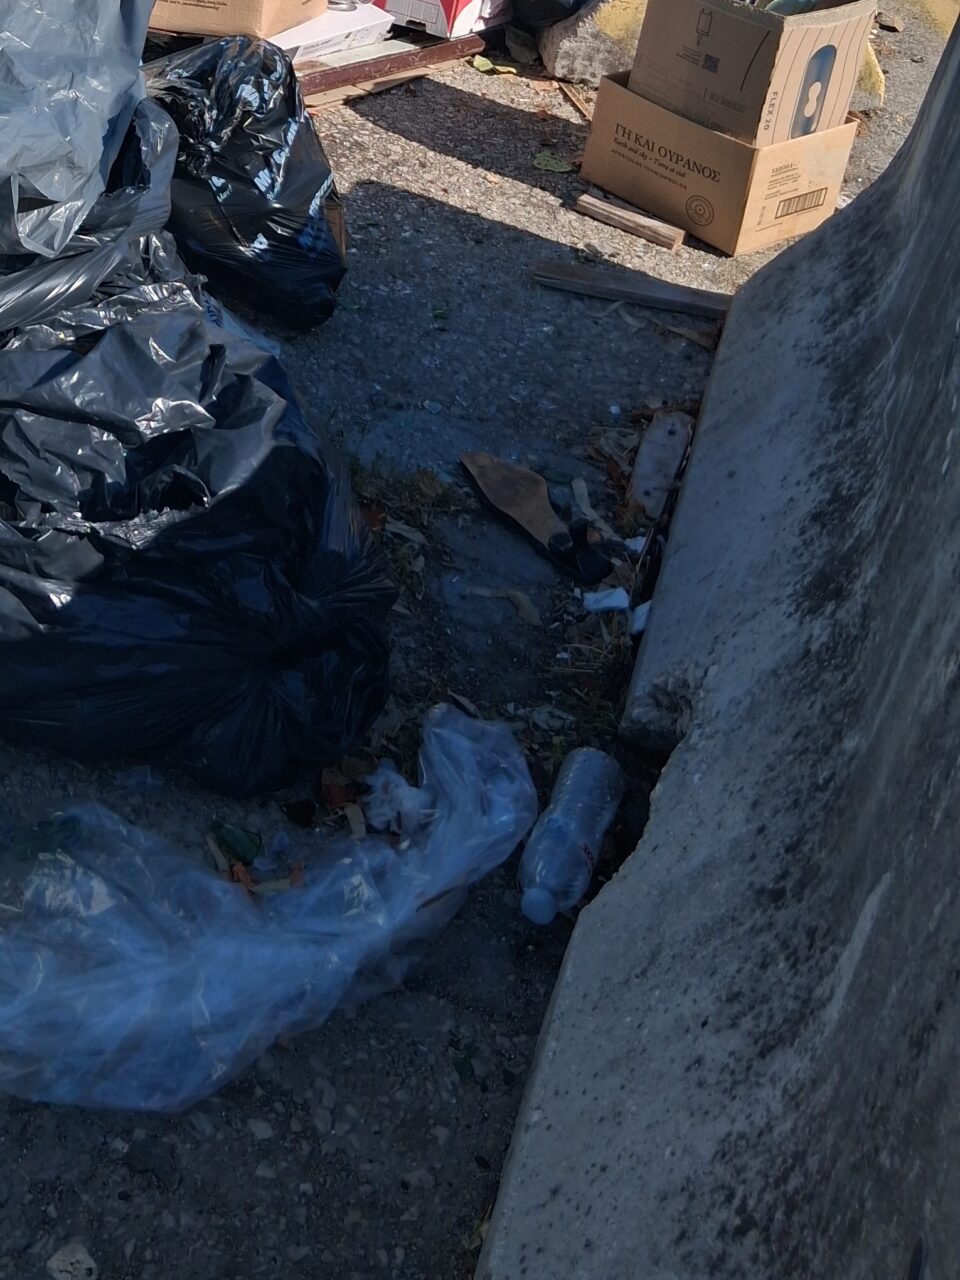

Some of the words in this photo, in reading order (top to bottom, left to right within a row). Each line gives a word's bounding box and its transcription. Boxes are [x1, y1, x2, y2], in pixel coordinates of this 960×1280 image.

[769, 91, 778, 114] FLEX
[615, 123, 633, 140] ΓΗ
[634, 134, 655, 153] ΚΑΙ
[658, 146, 721, 183] ΟΥΡΑΝΟΣ
